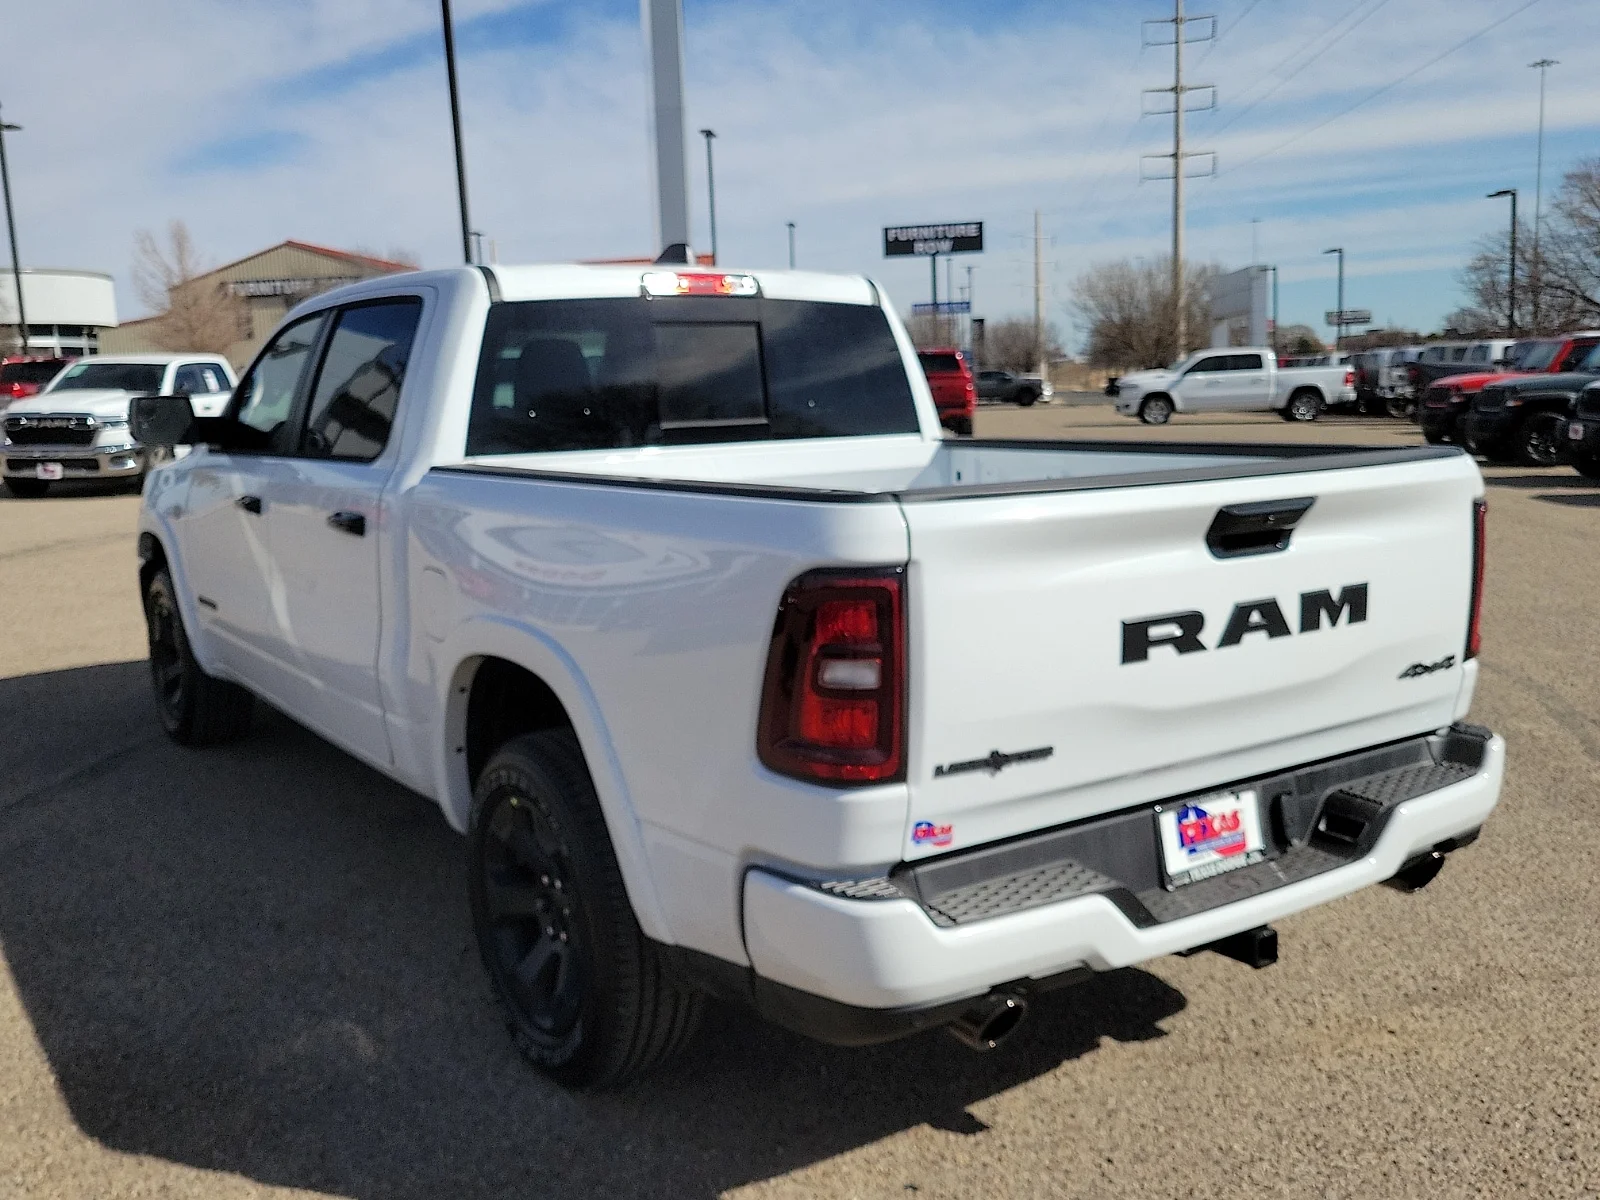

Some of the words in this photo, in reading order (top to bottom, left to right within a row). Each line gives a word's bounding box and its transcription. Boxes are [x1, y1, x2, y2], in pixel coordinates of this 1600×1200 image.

[887, 225, 980, 242] FURNITURE
[913, 241, 953, 255] ROW
[1121, 583, 1367, 665] RAM
